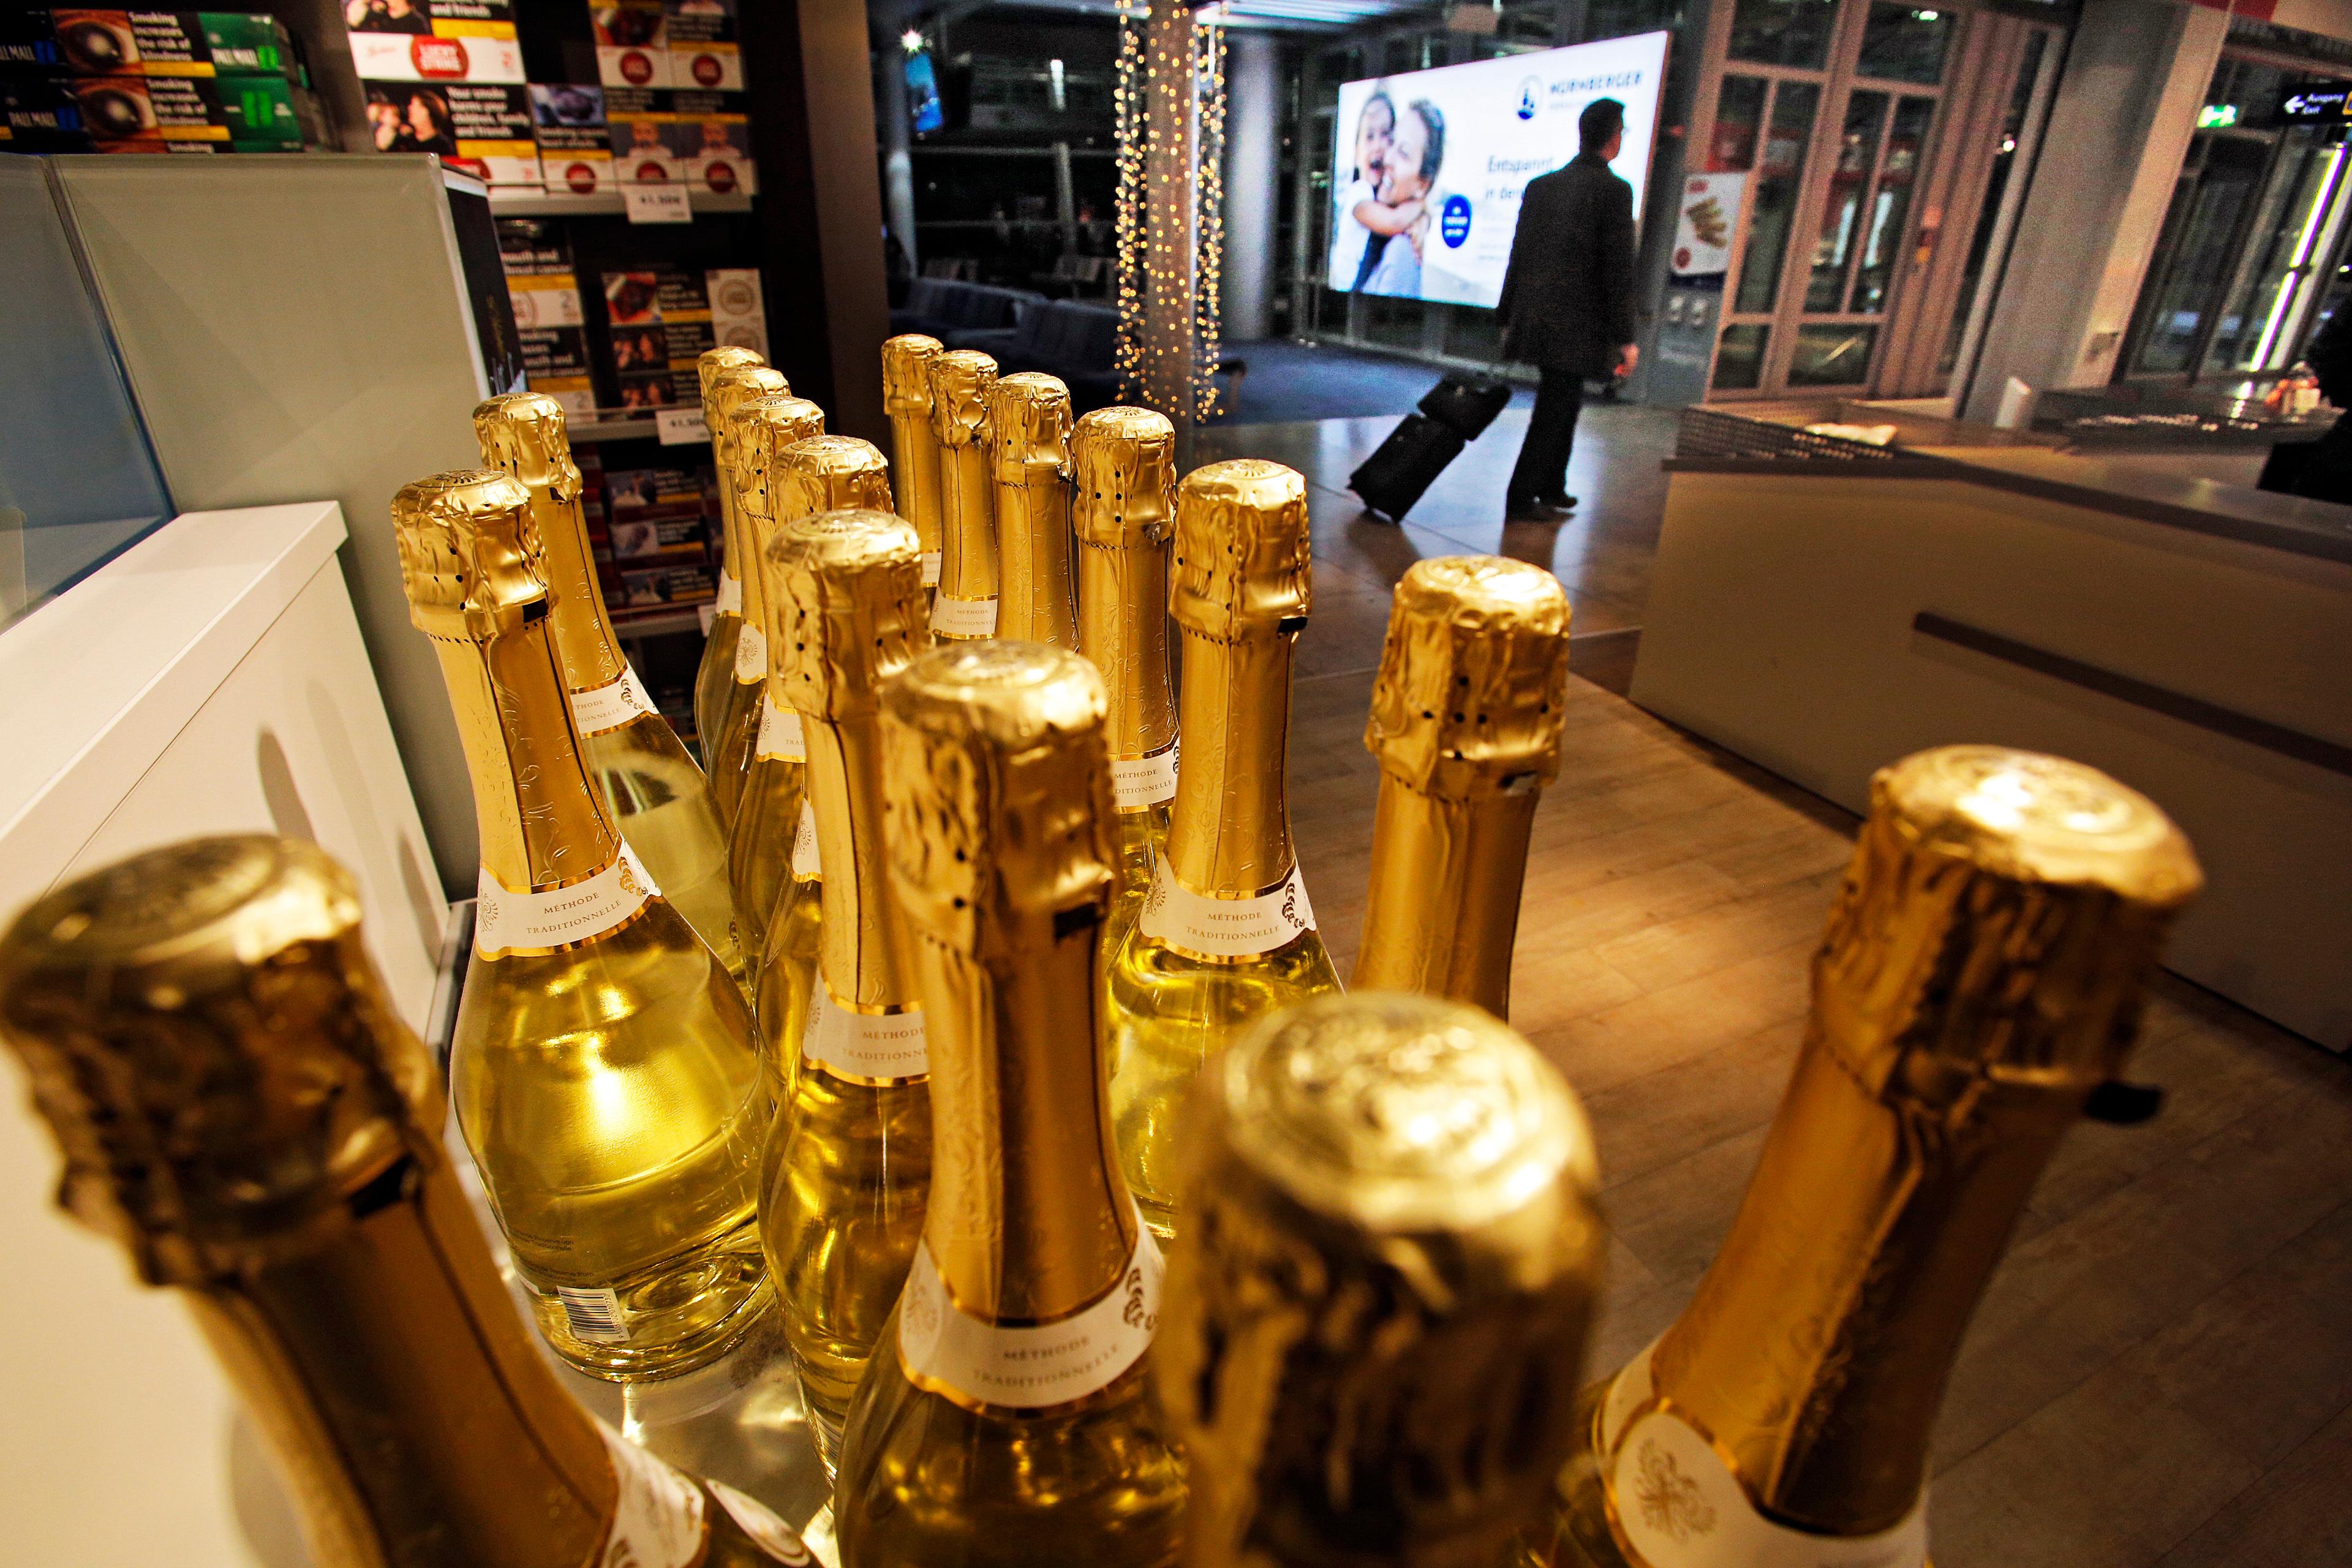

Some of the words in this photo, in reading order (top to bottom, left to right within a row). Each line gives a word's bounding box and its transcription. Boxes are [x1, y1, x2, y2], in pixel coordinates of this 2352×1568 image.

[576, 699, 604, 710] THODE
[1114, 769, 1157, 779] MÉTHODE
[1115, 779, 1172, 794] DITIONNELLE
[544, 891, 600, 914] MÉTHODE
[526, 899, 622, 935] TRADITIONNELLE
[1207, 910, 1263, 922] MÉTHODE
[1186, 924, 1280, 940] TRADITIONNELLE
[1003, 1336, 1088, 1360] MÉTHODE
